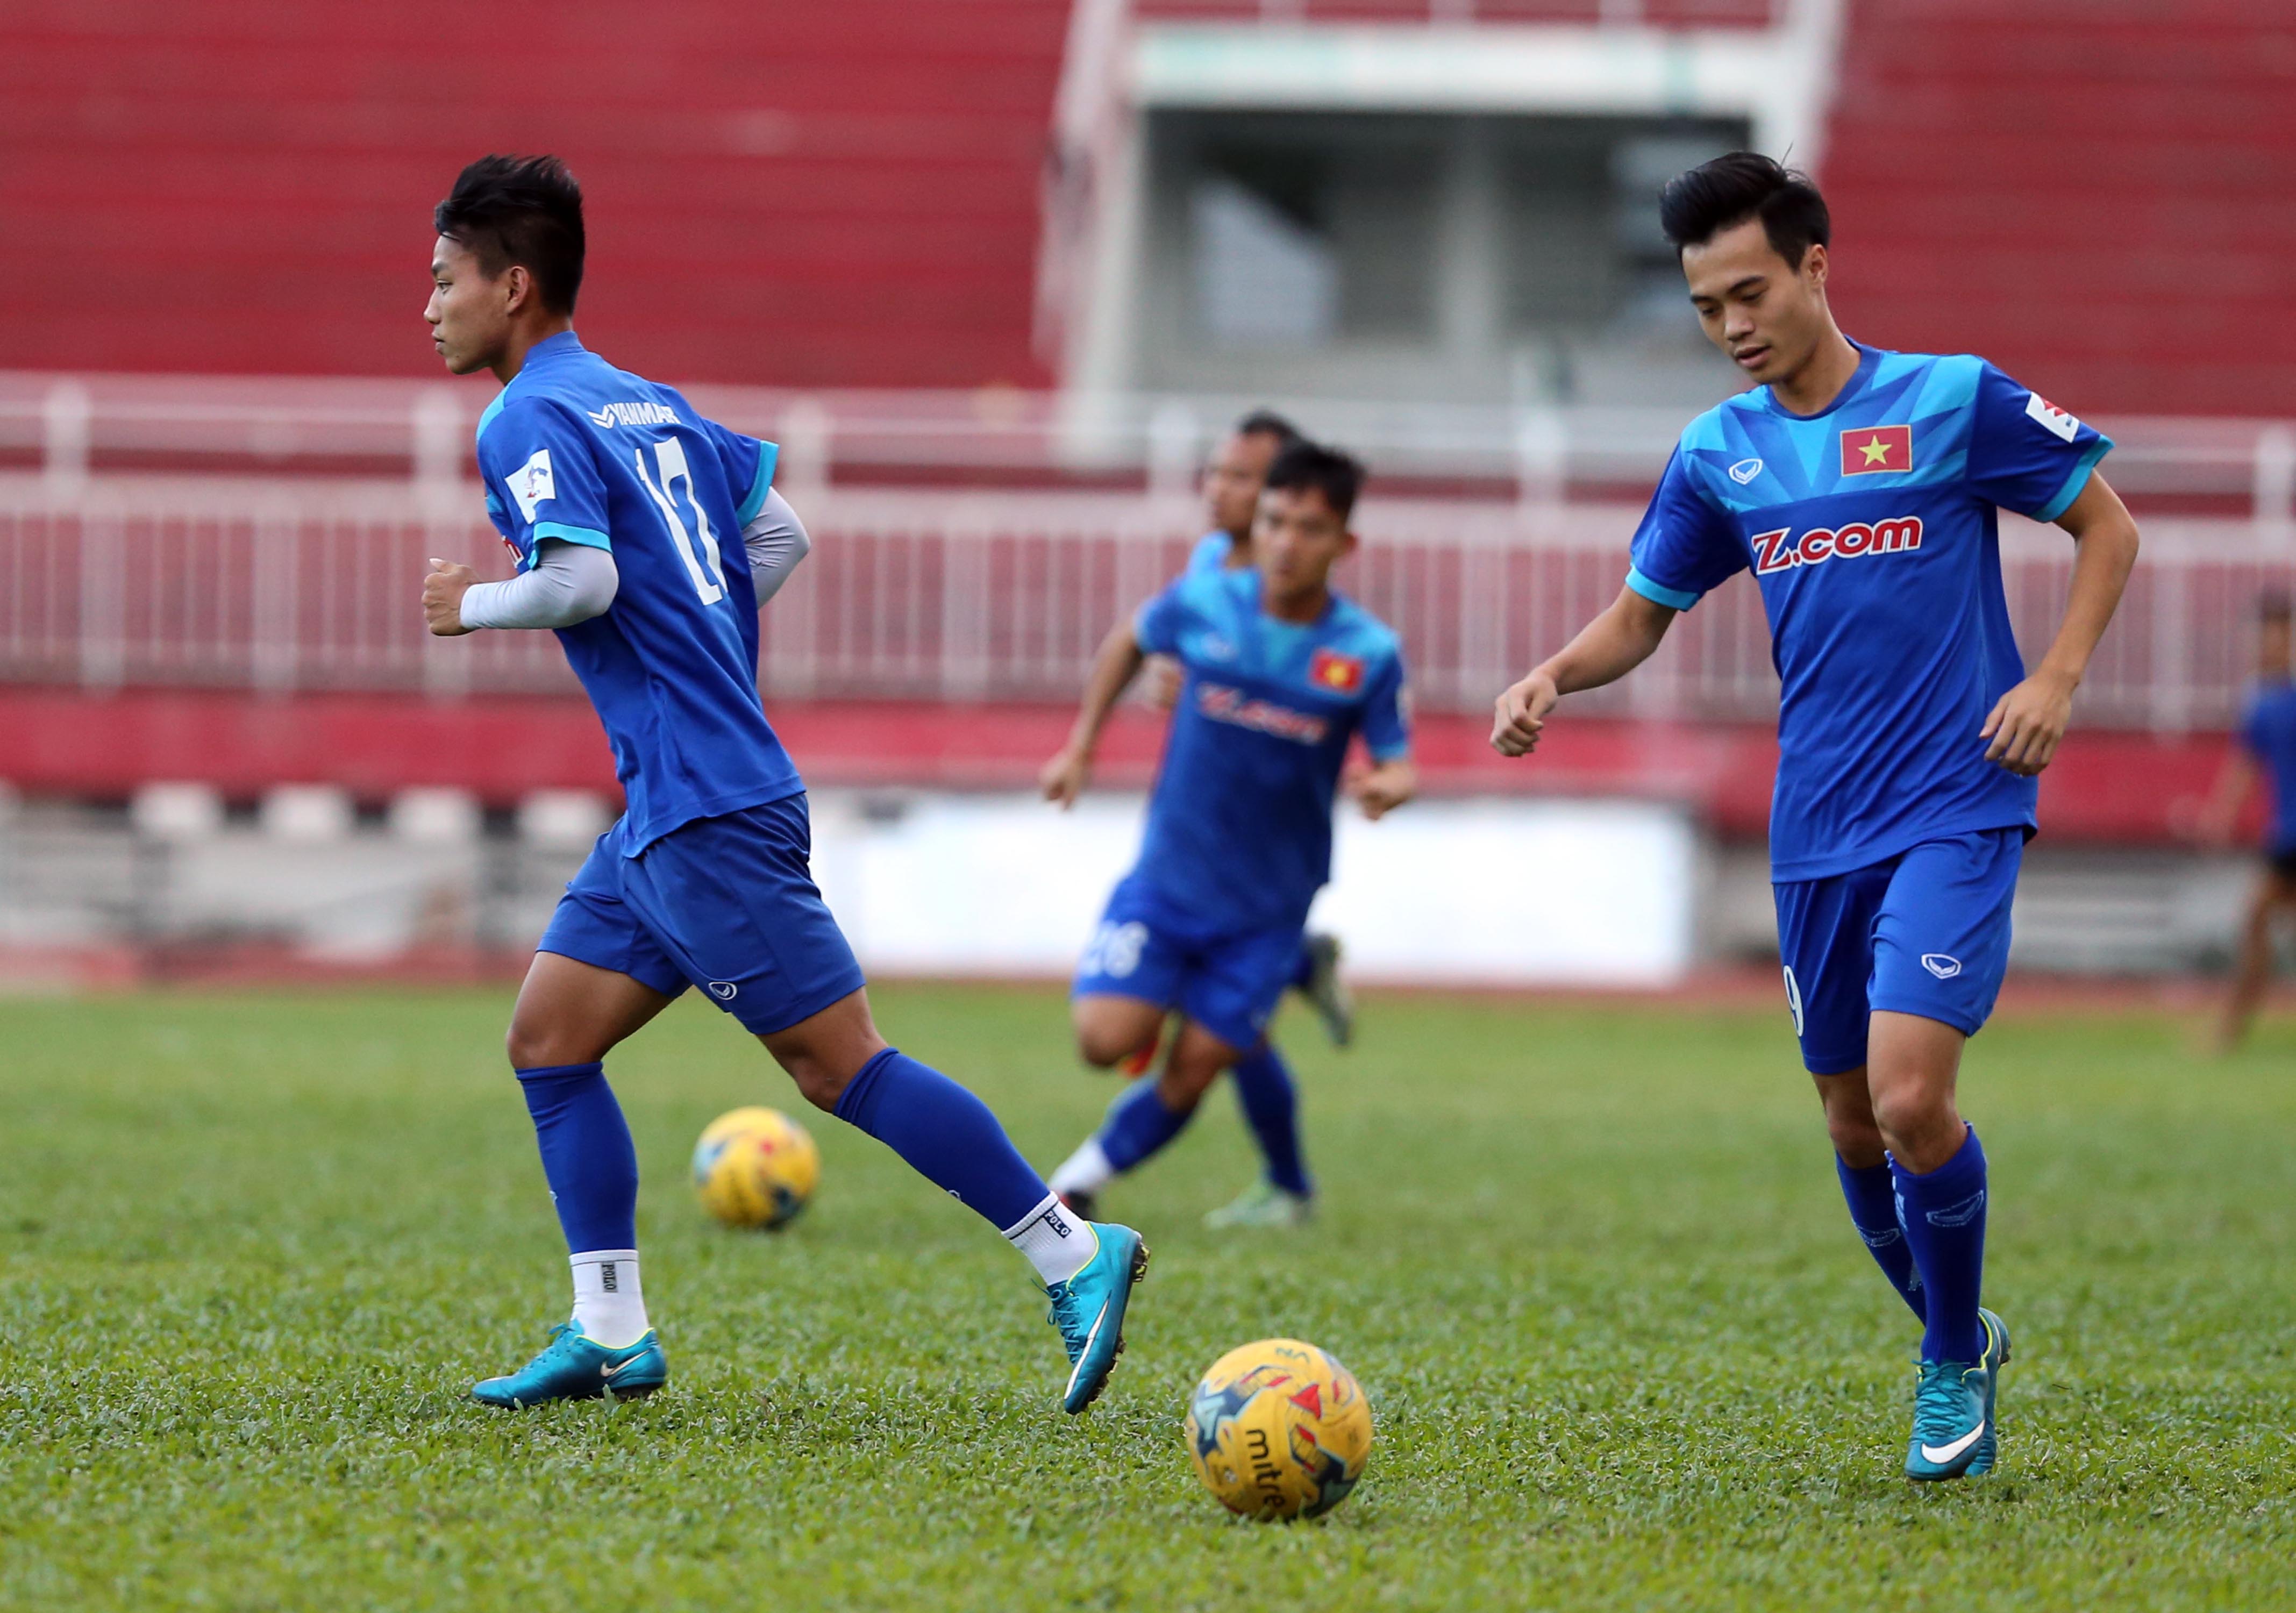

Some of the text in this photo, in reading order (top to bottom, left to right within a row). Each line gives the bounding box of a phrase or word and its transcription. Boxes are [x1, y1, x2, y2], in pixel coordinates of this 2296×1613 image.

[607, 402, 681, 426] YANMAR
[635, 436, 728, 605] 17
[1751, 516, 1923, 575] Z.com
[1044, 1210, 1069, 1235] POLO
[601, 1264, 617, 1290] POLO
[1246, 1429, 1286, 1508] mitre
